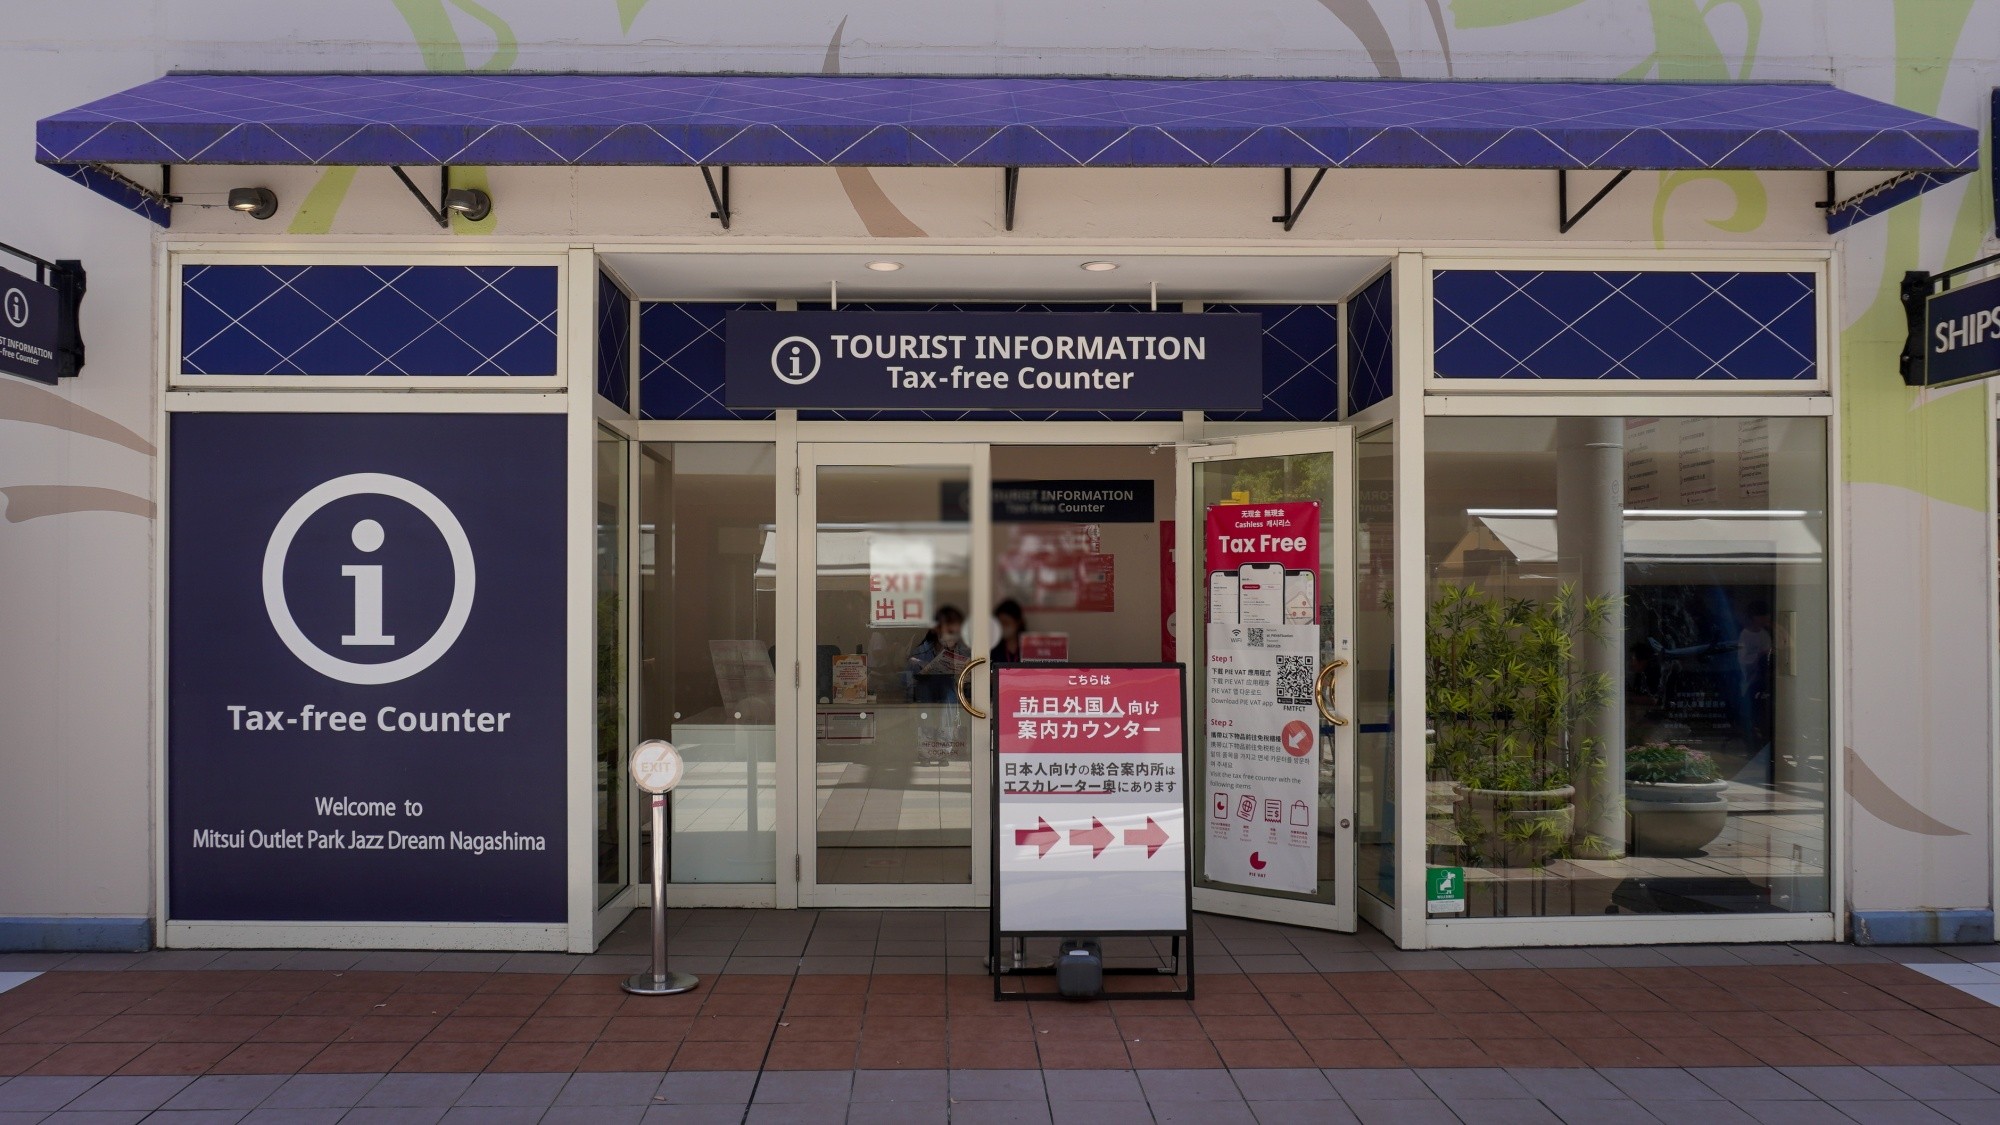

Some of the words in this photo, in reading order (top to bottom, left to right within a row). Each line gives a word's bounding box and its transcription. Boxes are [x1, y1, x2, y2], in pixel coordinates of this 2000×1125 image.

[1935, 305, 2000, 354] SHIPS
[7, 338, 53, 360] INFORMATION
[831, 335, 967, 359] TOURIST
[975, 336, 1206, 360] INFORMATION
[15, 352, 40, 365] Counter
[887, 366, 1009, 389] Tax-free
[1017, 366, 1134, 390] Counter
[1041, 490, 1133, 501] INFORMATION
[1058, 503, 1105, 513] Counter
[1218, 535, 1256, 553] Tax
[1260, 535, 1307, 552] Free
[870, 573, 925, 592] EXIT
[876, 598, 924, 620] 出口
[1212, 655, 1227, 663] Step
[1068, 674, 1111, 686] こちらは
[1019, 696, 1160, 716] 訪日外国人向け
[227, 704, 368, 732] Tax-free
[377, 706, 511, 733] Counter
[1211, 719, 1227, 727] Step
[1018, 720, 1161, 740] 案内カウンター
[641, 762, 671, 772] EXIT
[1005, 762, 1176, 777] 日本人向けの総合案内所は
[1004, 779, 1177, 794] エスカレーター奥にあります
[1210, 781, 1234, 789] following
[315, 797, 396, 817] Welcome
[404, 798, 423, 817] to
[193, 829, 245, 849] Mitsui
[249, 830, 303, 850] Outlet
[307, 830, 345, 850] Park
[347, 831, 384, 850] Jazz
[388, 831, 445, 851] Dream
[450, 832, 546, 855] Nagashima
